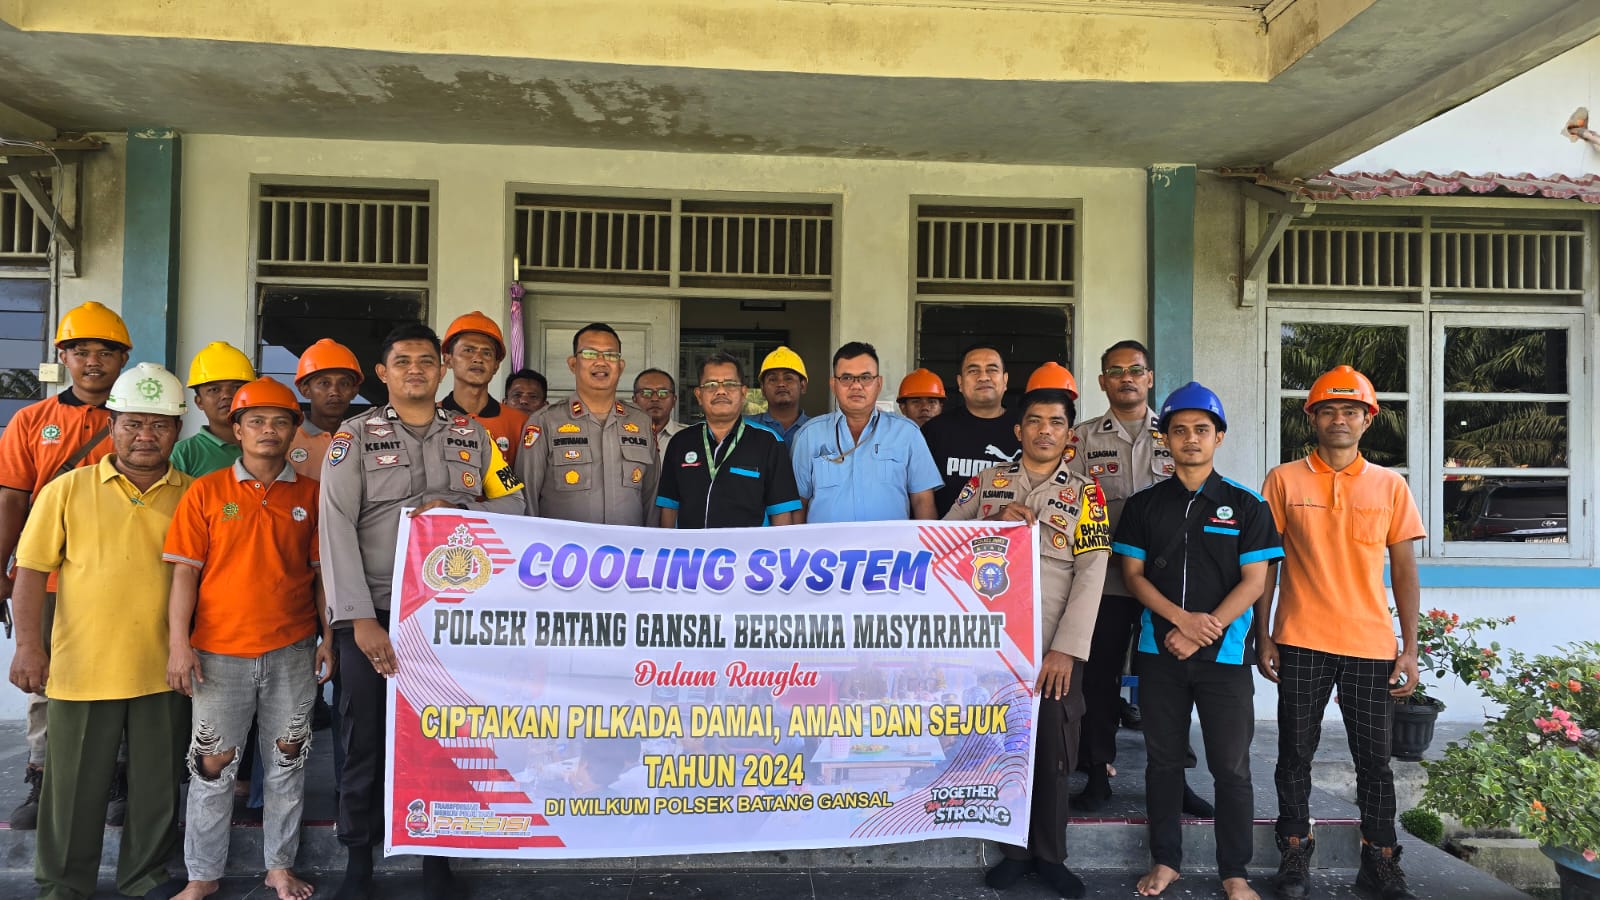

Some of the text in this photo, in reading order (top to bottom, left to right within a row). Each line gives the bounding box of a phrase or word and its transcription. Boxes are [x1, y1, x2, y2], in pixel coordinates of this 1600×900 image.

[365, 441, 401, 452] KEMIT
[447, 437, 478, 450] POLRI
[947, 457, 1001, 477] PUM
[1048, 498, 1079, 517] POLRI
[518, 542, 933, 594] COOLING SYSTEM
[433, 609, 1004, 649] POLSEK BATANG GANSAL BERSAMA MASYARAKAT
[634, 660, 818, 696] Dalam Rangka
[420, 704, 1011, 744] CIPTAKAN PILKADA DAMAI, AMAN DAN SEJUK
[644, 753, 805, 788] TAHUN 2024
[544, 791, 893, 816] DI WILKUM POLSEK BATANG GANSAL
[931, 785, 997, 801] TOGETHER
[434, 815, 531, 832] PRESISI
[935, 804, 1010, 825] STRONG
